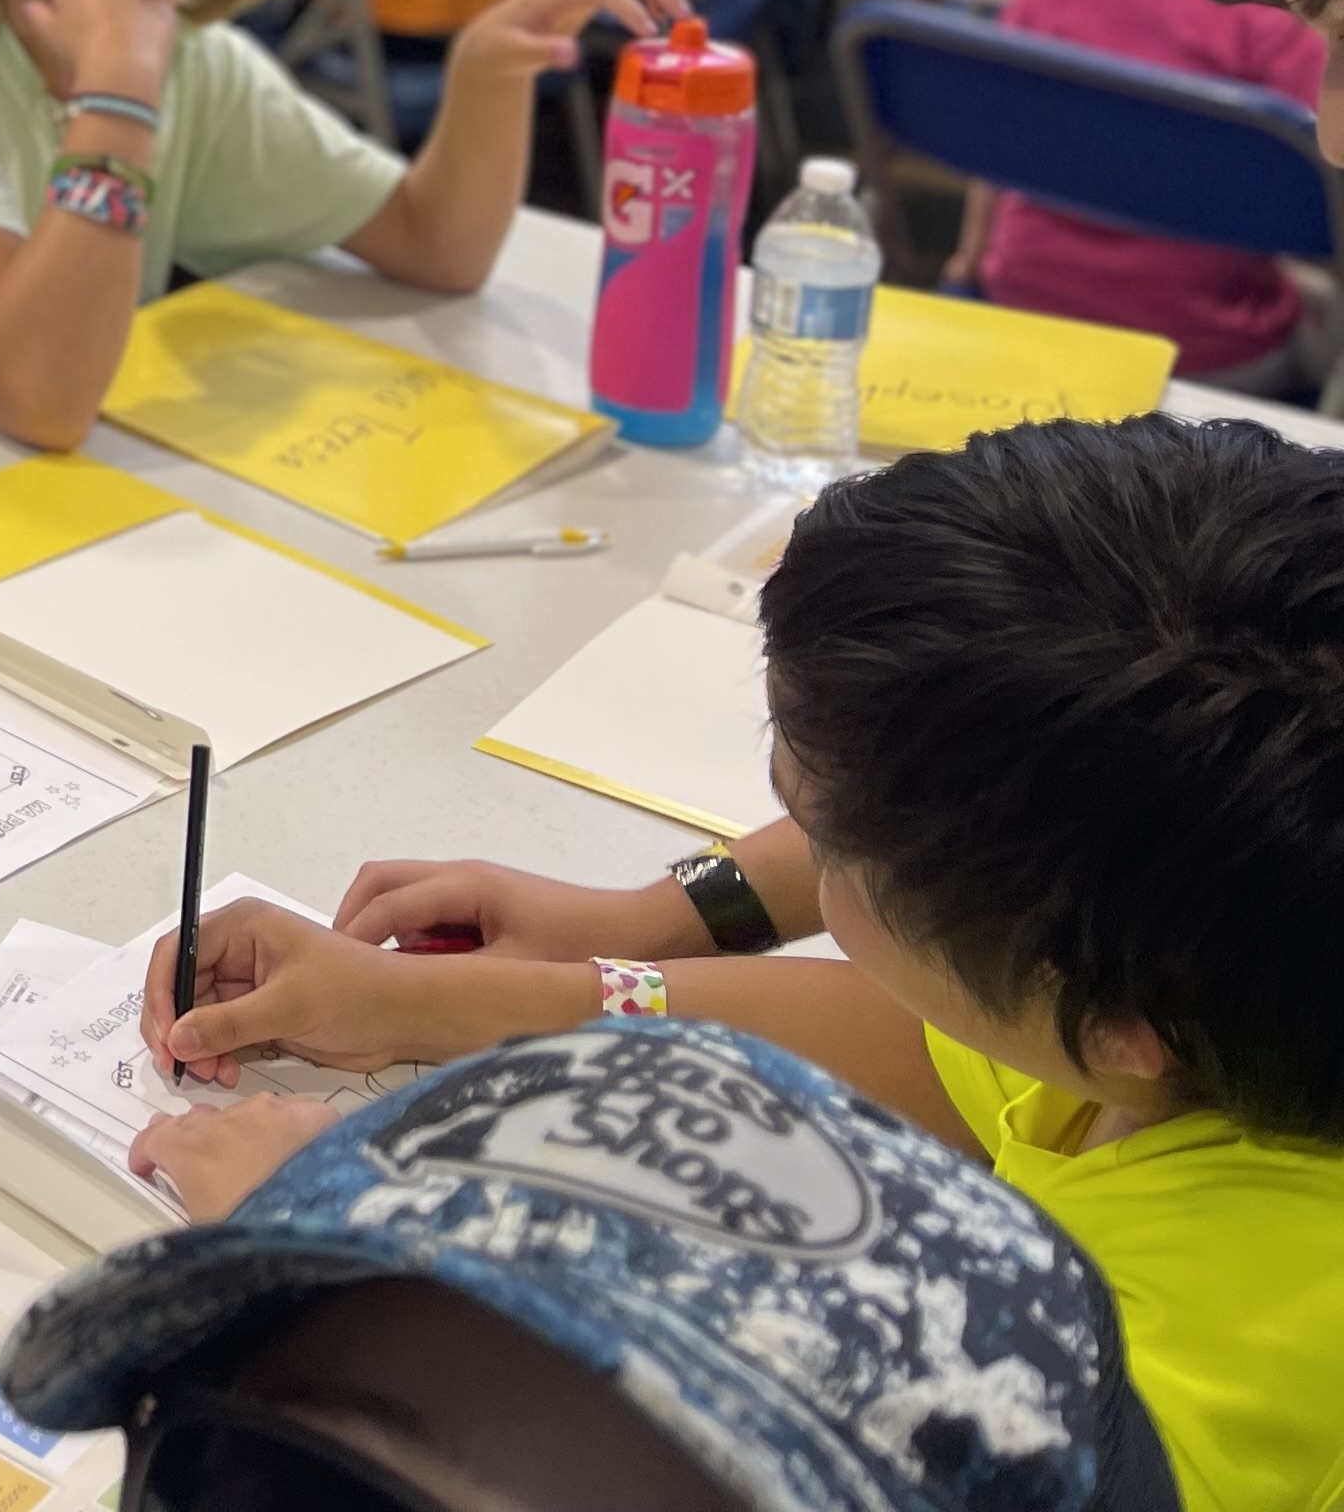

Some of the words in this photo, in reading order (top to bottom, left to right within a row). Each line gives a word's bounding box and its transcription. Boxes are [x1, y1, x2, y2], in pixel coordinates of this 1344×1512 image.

[15, 800, 52, 819] MA
[81, 1016, 122, 1042] MA
[572, 1074, 731, 1145] Pro
[584, 1034, 796, 1138] Bass
[545, 1108, 811, 1242] Shops
